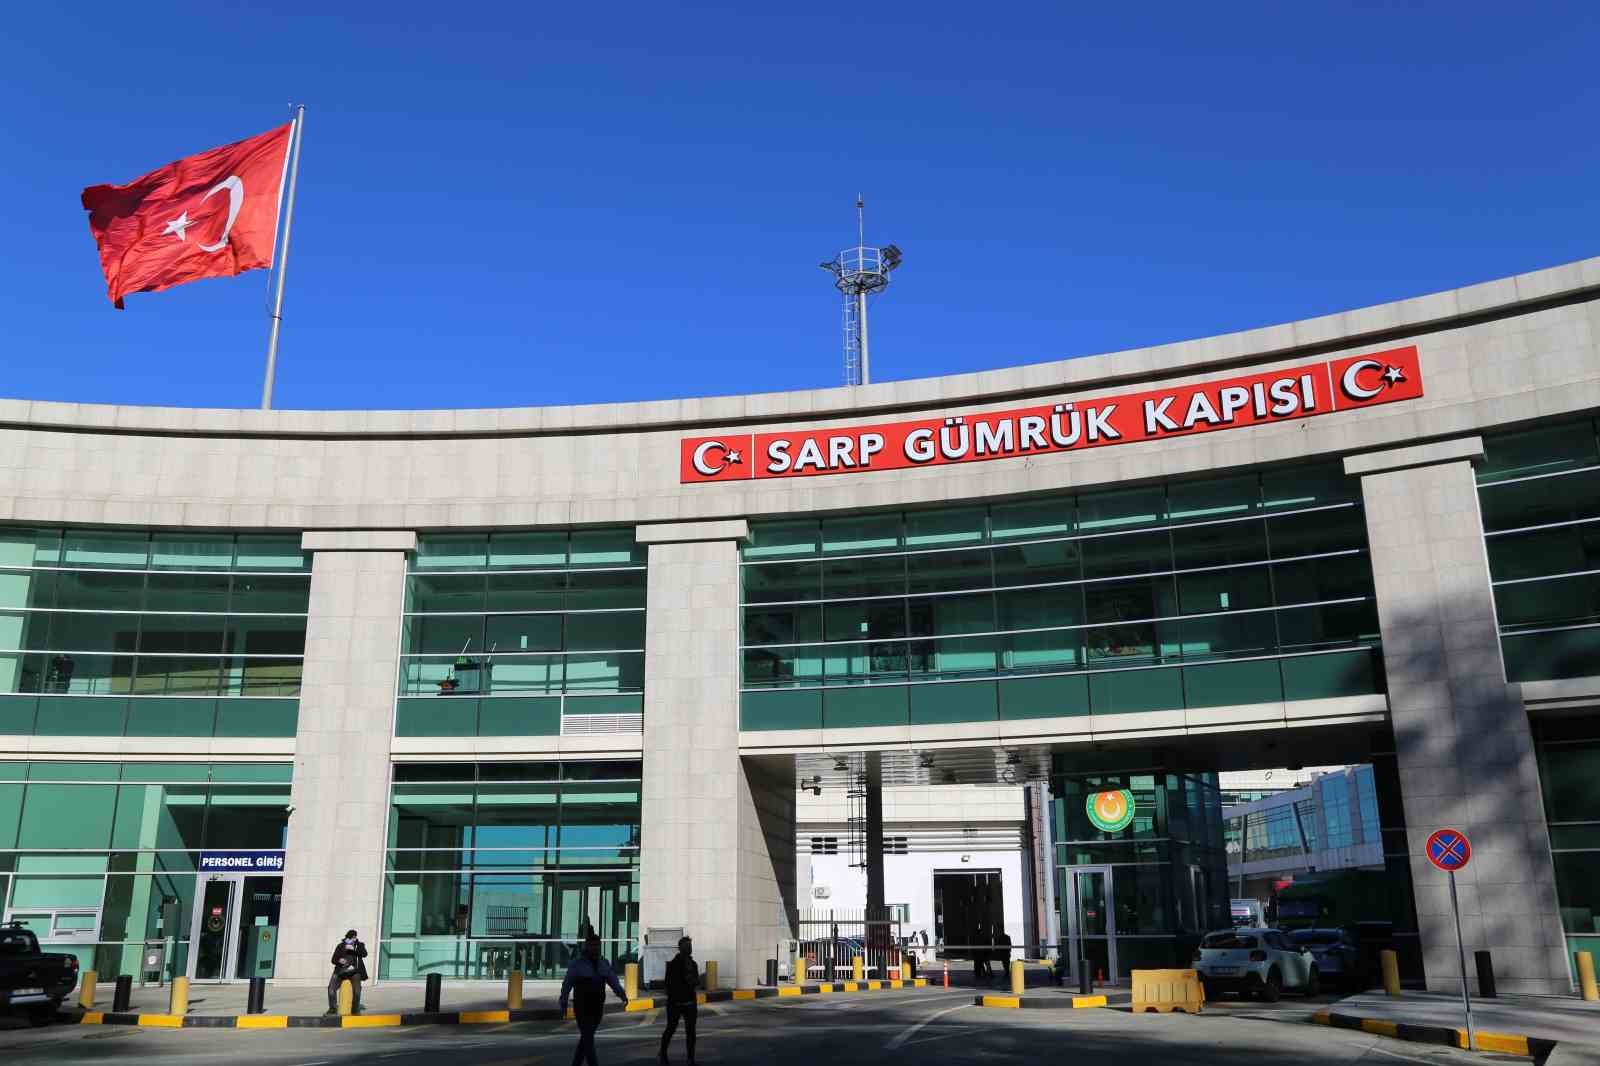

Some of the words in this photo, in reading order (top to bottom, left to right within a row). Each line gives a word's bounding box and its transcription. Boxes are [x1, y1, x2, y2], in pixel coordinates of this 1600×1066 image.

[767, 433, 885, 474] SARP
[903, 403, 1121, 463] GÜMRÜK
[1143, 374, 1316, 435] KAPISI
[202, 857, 254, 867] PERSONEL
[256, 855, 283, 869] GİRİŞ
